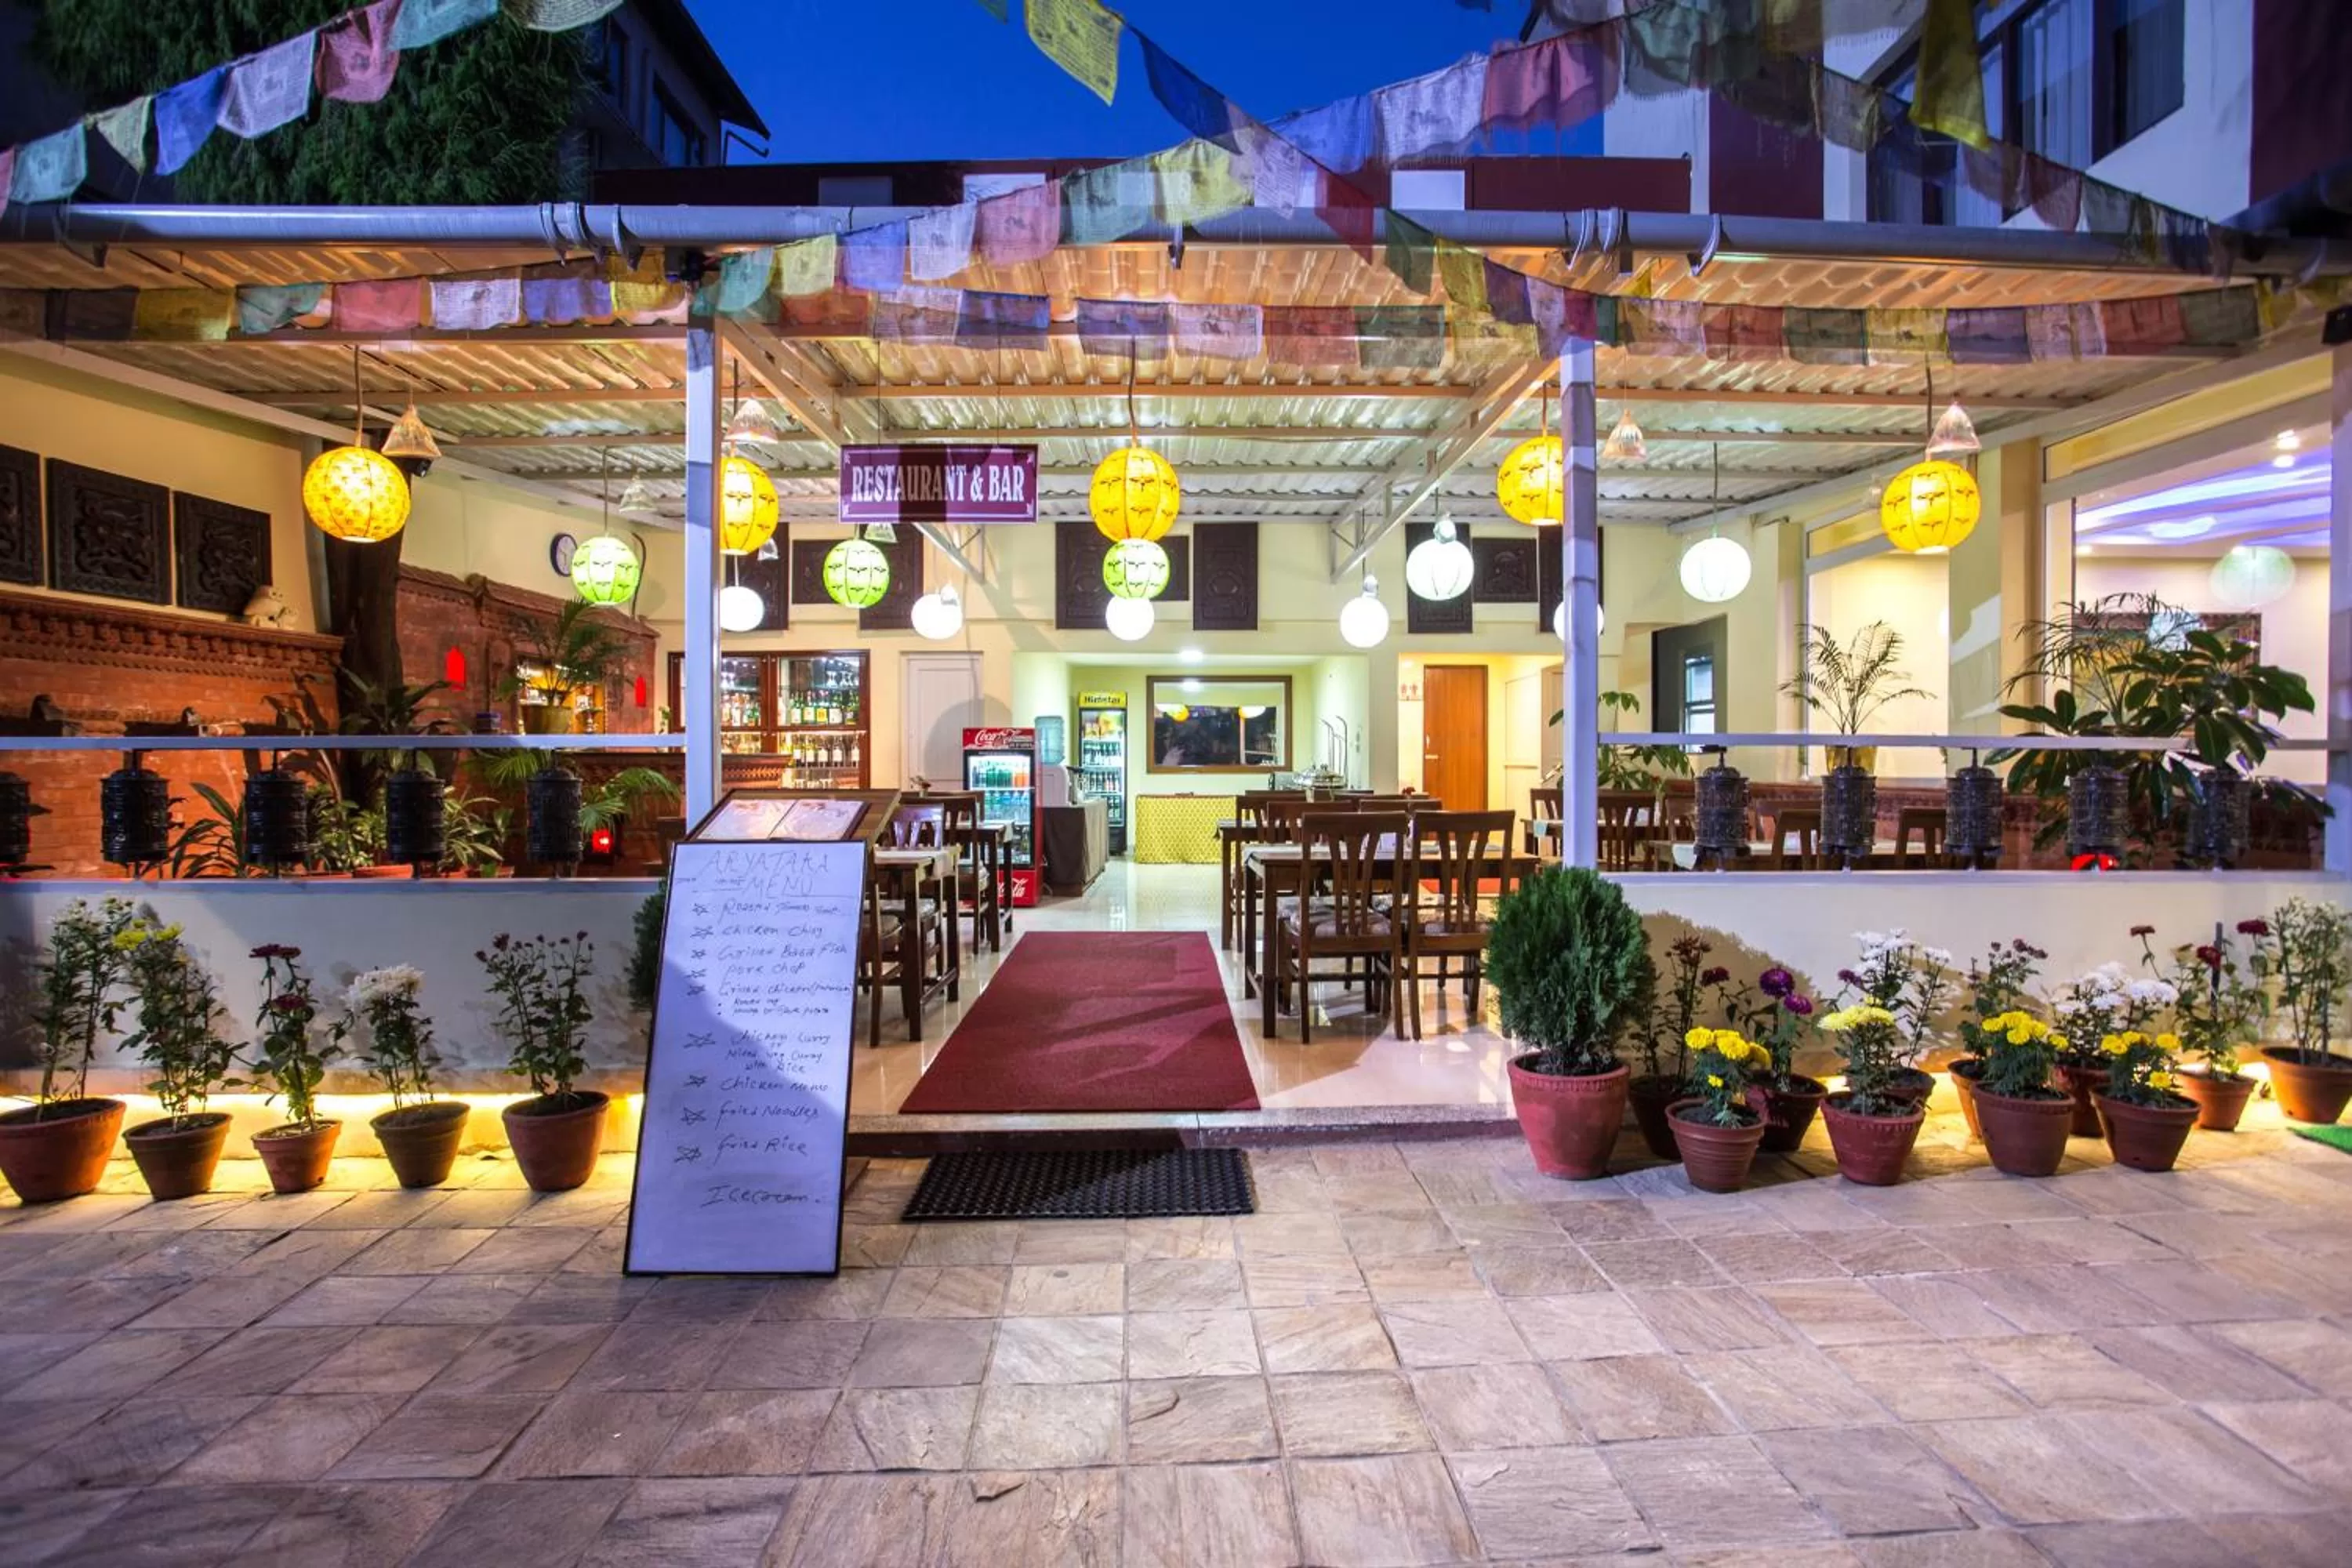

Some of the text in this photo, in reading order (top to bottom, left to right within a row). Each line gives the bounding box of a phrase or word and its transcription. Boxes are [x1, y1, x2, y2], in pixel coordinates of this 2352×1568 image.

[851, 463, 1024, 503] RESTAURANT & BAR
